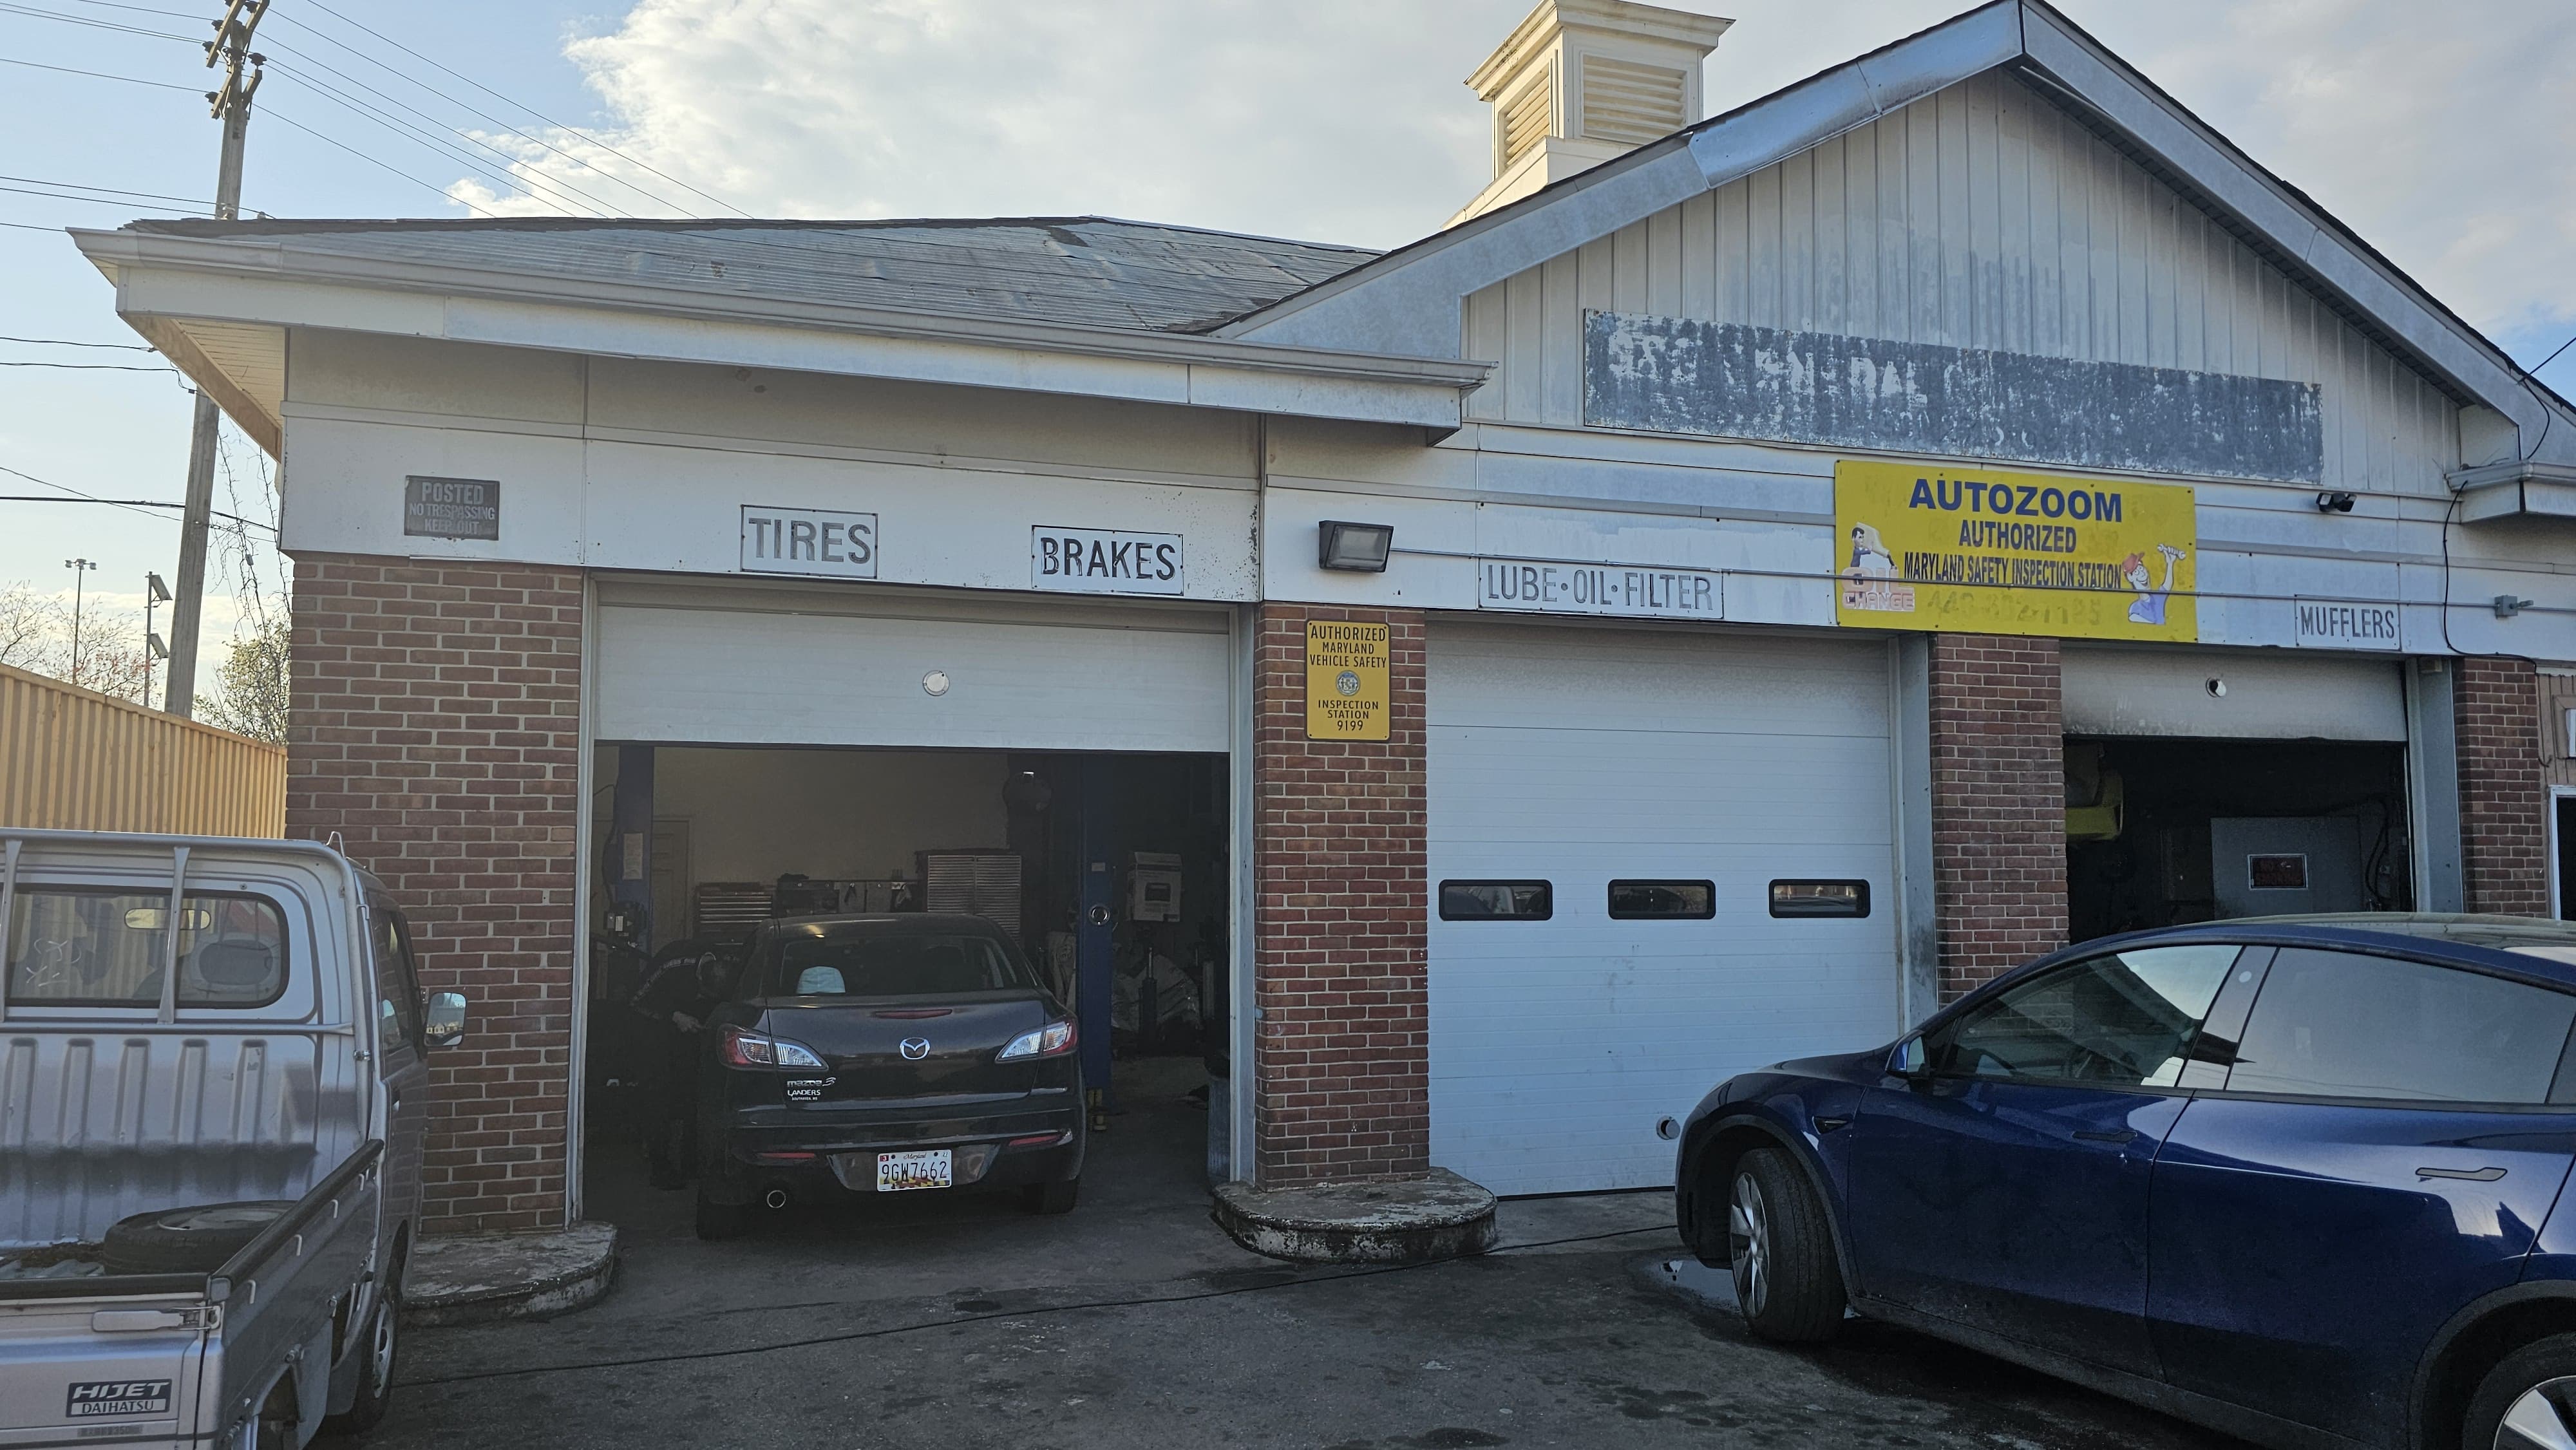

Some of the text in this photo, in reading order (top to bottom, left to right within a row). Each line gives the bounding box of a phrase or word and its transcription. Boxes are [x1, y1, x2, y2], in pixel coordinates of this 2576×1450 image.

[422, 482, 483, 505] POSTED
[1908, 478, 2122, 523] AUTOZOOM
[409, 502, 495, 520] NO TRESPASSING
[424, 518, 480, 535] KEEP OUT
[748, 517, 871, 565] TIRES
[1958, 519, 2077, 554] AUTHORIZED
[1040, 537, 1176, 581] BRAKES
[1904, 551, 2122, 589] MARYLAND SAFETY INSPECTION STATION
[1841, 567, 1915, 592] OIL
[1842, 591, 1915, 611] CHANGE
[2300, 605, 2395, 639] MUFFLERS
[1311, 625, 1386, 641] AUTHORIZED
[1322, 642, 1374, 654] MARYLAND
[1310, 654, 1387, 668] VEHICLE SAFETY
[1318, 699, 1379, 710] INSPECTION
[1327, 710, 1369, 719] STATION
[1337, 720, 1363, 731] 9199
[787, 1089, 821, 1097] LANDERS
[903, 1153, 927, 1161] Maryland
[882, 1160, 947, 1182] 9GW7662
[73, 1382, 170, 1400] HIJET
[82, 1400, 154, 1414] DAIHATSU
